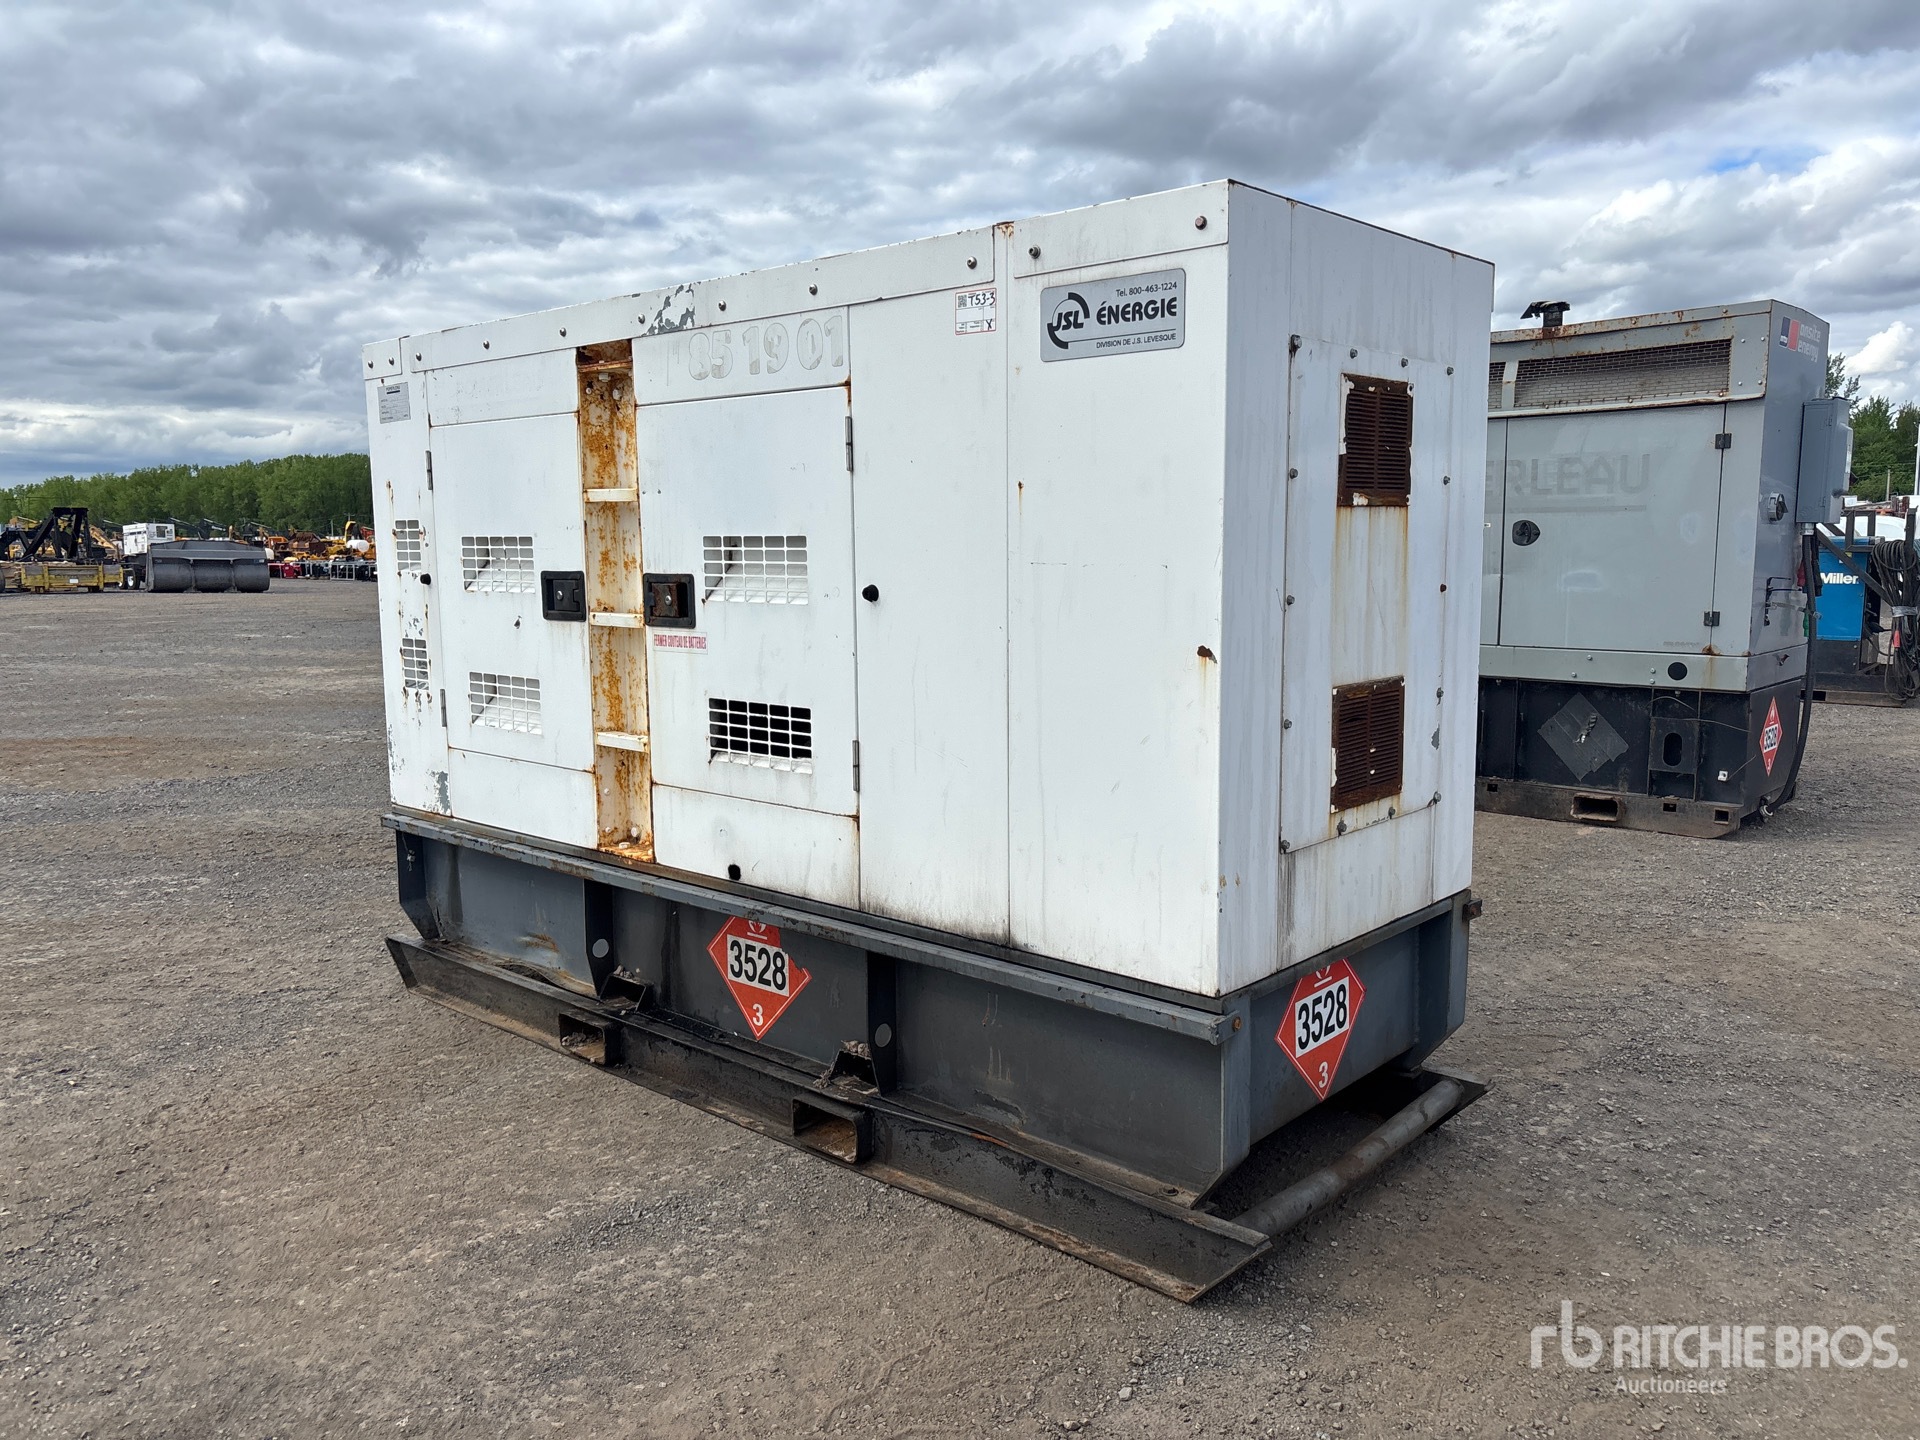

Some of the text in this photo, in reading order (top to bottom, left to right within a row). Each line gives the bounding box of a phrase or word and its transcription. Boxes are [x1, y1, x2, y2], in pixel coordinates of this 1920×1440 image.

[1116, 281, 1178, 298] Tel. 800-463-1224
[1052, 296, 1177, 332] JSL ÉNERGIE
[1096, 340, 1122, 349] DIVISION
[1122, 338, 1131, 347] DE
[1132, 336, 1143, 345] J.S.
[1820, 572, 1859, 585] Miller
[729, 939, 787, 991] 3528
[752, 1003, 764, 1026] 3
[1298, 983, 1348, 1050] 3528
[1318, 1061, 1329, 1088] 3
